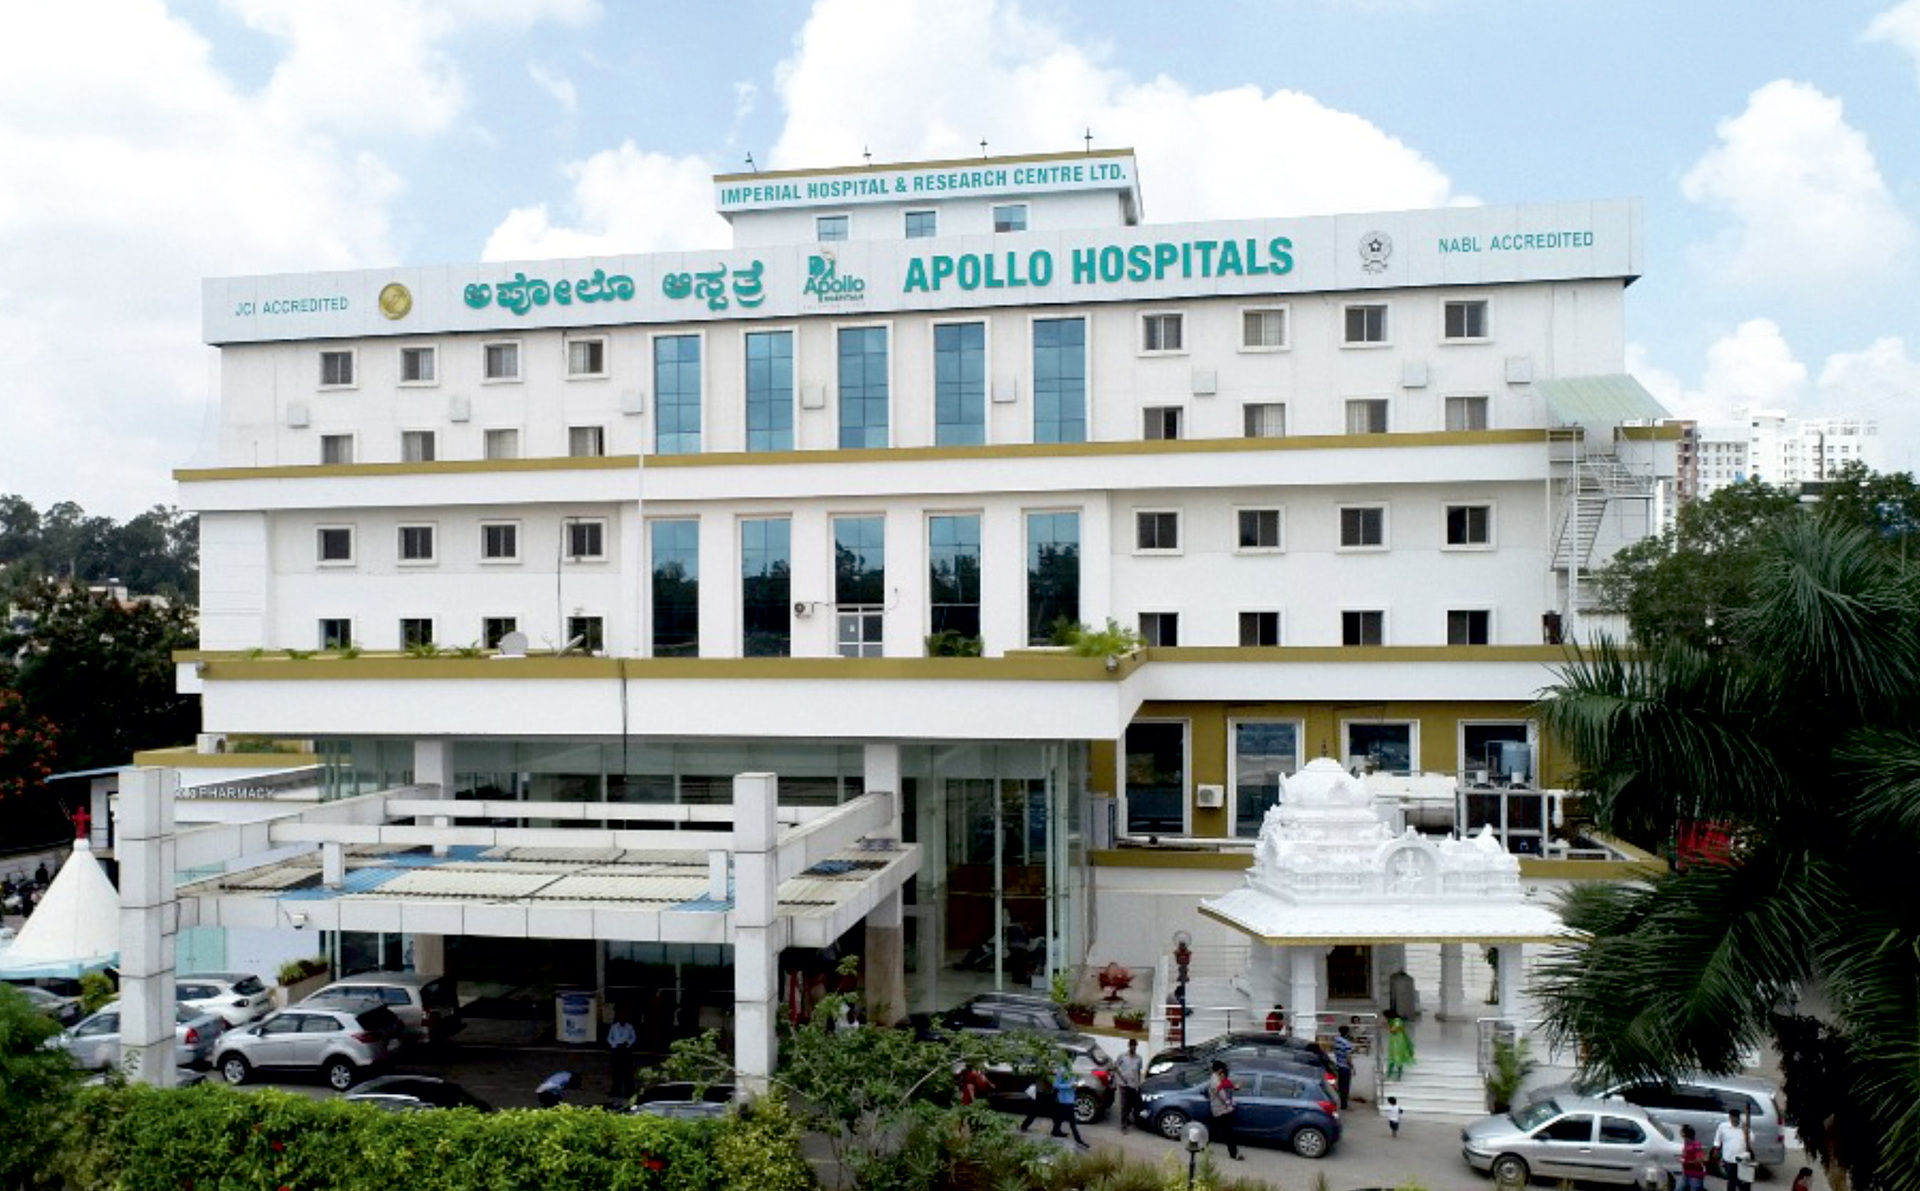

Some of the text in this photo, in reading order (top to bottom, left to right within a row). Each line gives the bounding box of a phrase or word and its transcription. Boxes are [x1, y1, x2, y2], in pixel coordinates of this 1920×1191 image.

[721, 163, 1127, 204] IMPERIAL HOSPITAL & RESEARCH CENTRE LTD.
[1438, 231, 1594, 254] NABL ACCREDITED
[903, 237, 1295, 293] APOLLO HOSPITALS
[803, 275, 865, 302] Apollo
[235, 296, 349, 317] JCI ACCREDITED
